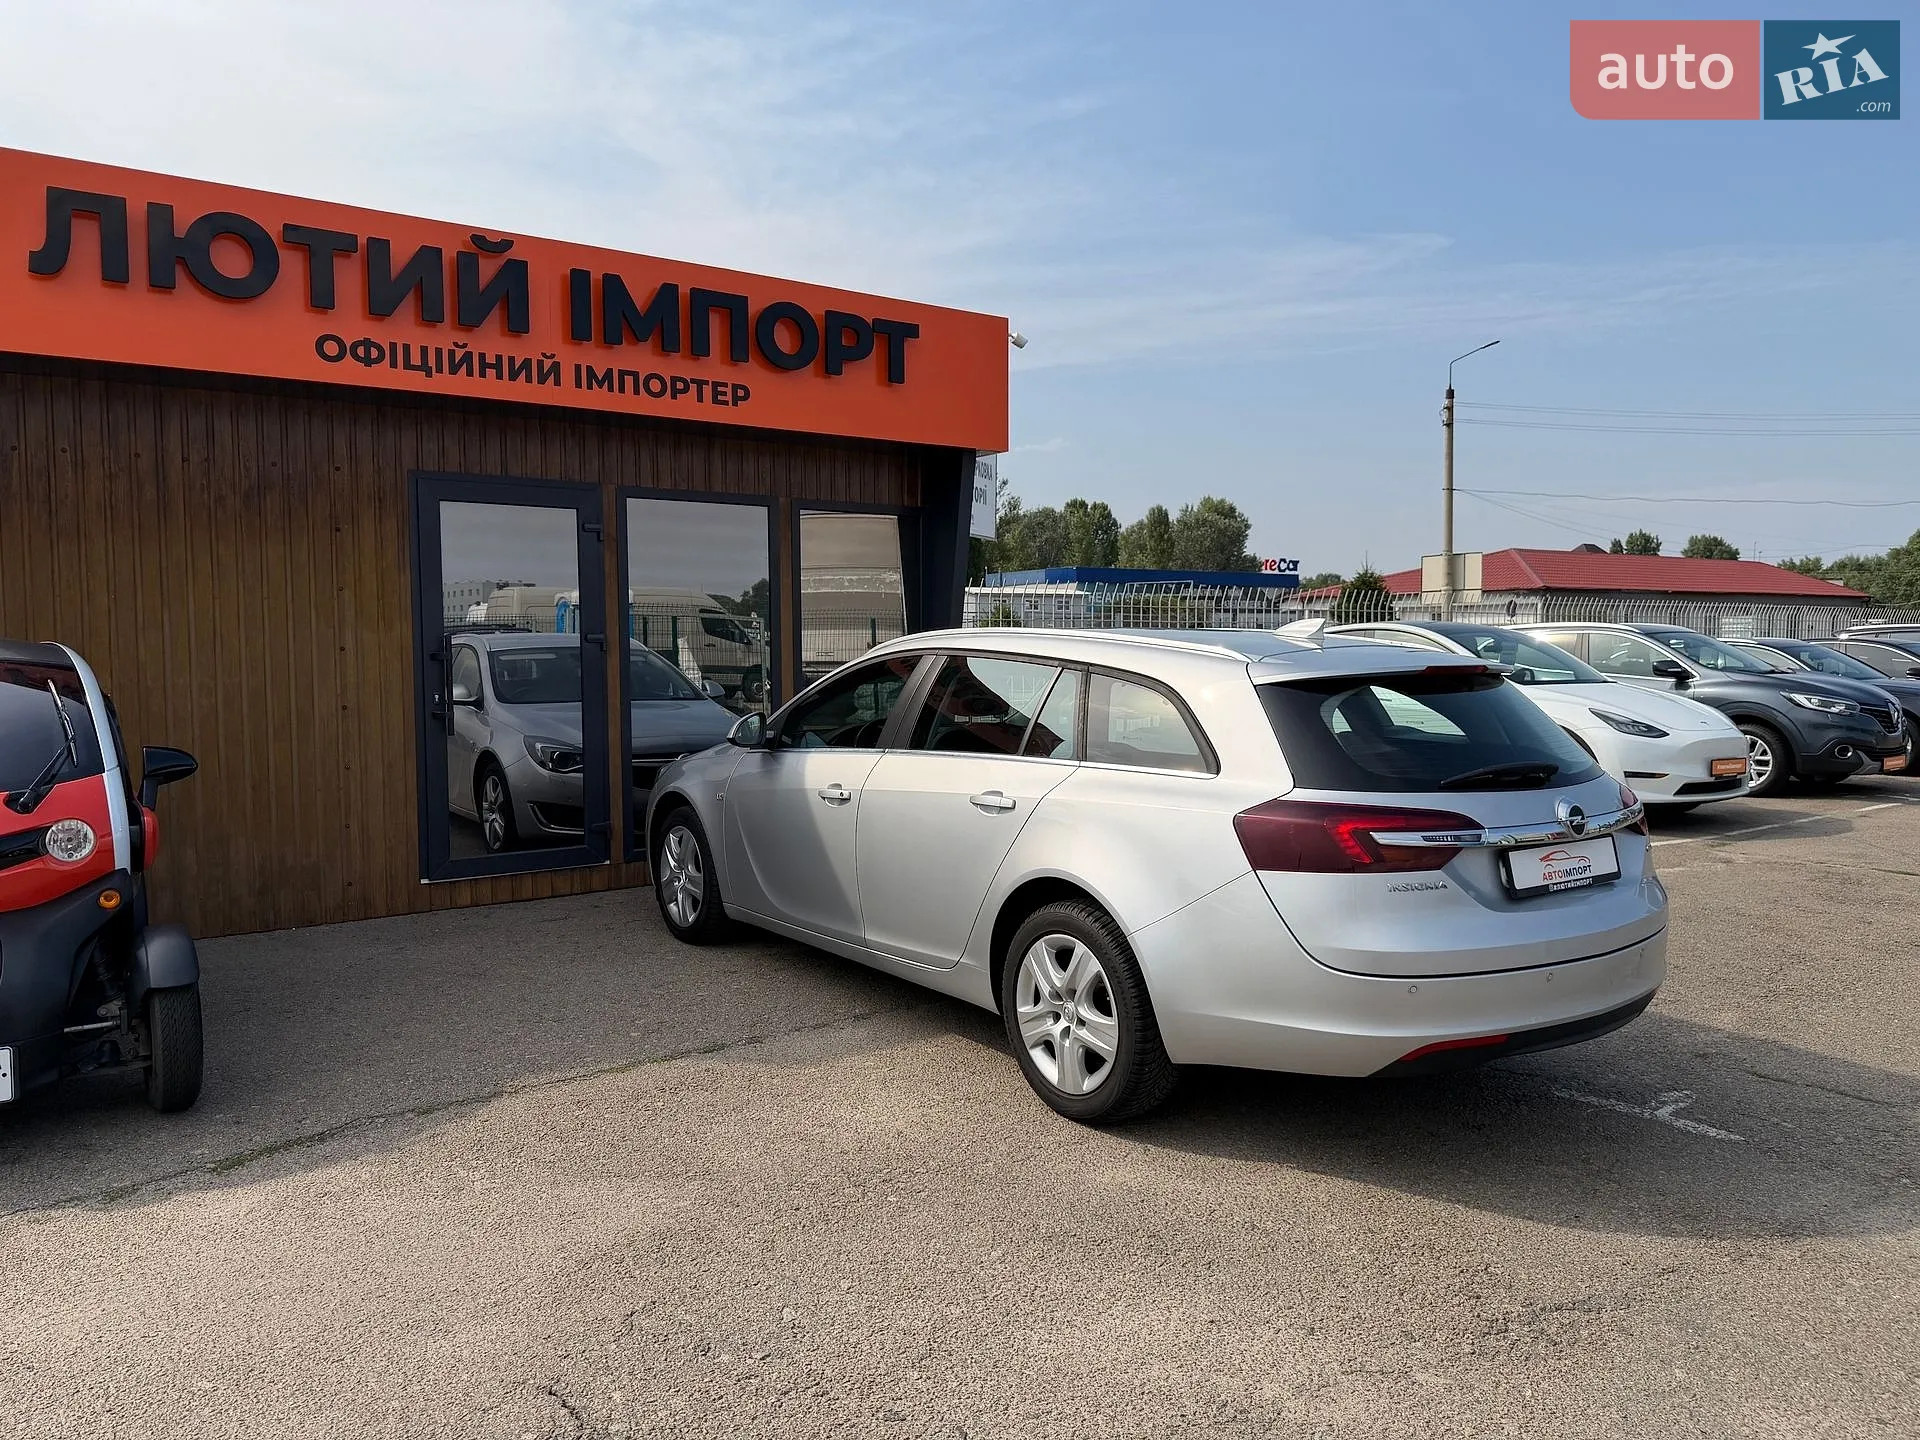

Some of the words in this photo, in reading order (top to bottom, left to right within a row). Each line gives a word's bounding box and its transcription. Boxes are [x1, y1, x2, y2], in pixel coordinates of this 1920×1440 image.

[28, 185, 531, 337] ЛЮТИЙ
[569, 267, 920, 386] ІМПОРТ
[314, 333, 562, 388] ОФІЦІЙНИЙ
[574, 363, 752, 409] ІМПОРТЕР
[1542, 864, 1593, 882] АВТОІМПОРТ
